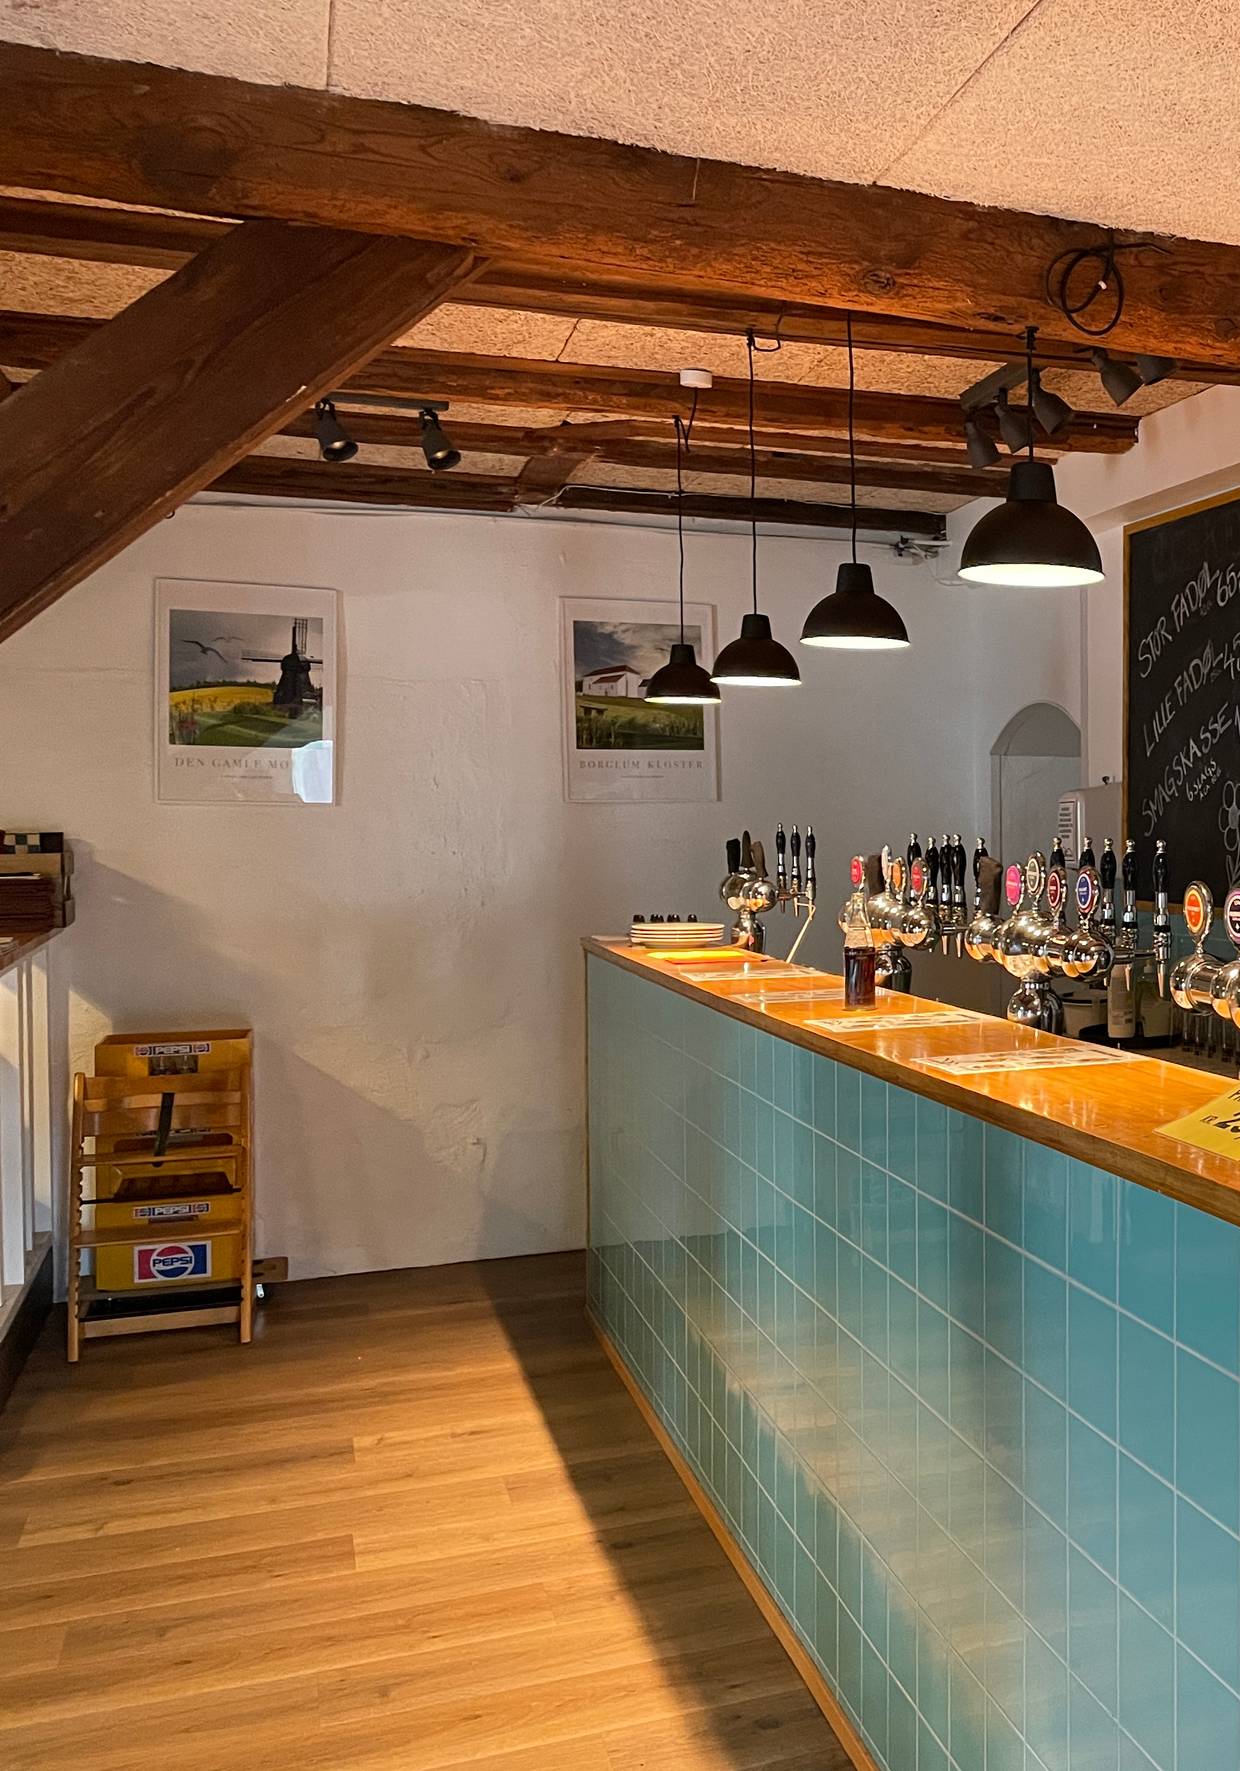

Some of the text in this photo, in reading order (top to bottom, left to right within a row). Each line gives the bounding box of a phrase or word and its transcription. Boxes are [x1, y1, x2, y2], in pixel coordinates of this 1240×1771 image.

[1138, 616, 1173, 678] STOR
[1171, 560, 1220, 632] FADØL
[1143, 690, 1176, 757] LILLE
[1174, 639, 1223, 705] FADØL
[647, 759, 704, 769] KLOSTER
[1142, 701, 1232, 837] SMAGSKASSE
[156, 1045, 190, 1054] PEPSI
[155, 1206, 189, 1215] PEPSI
[152, 1256, 193, 1267] PEPSI
